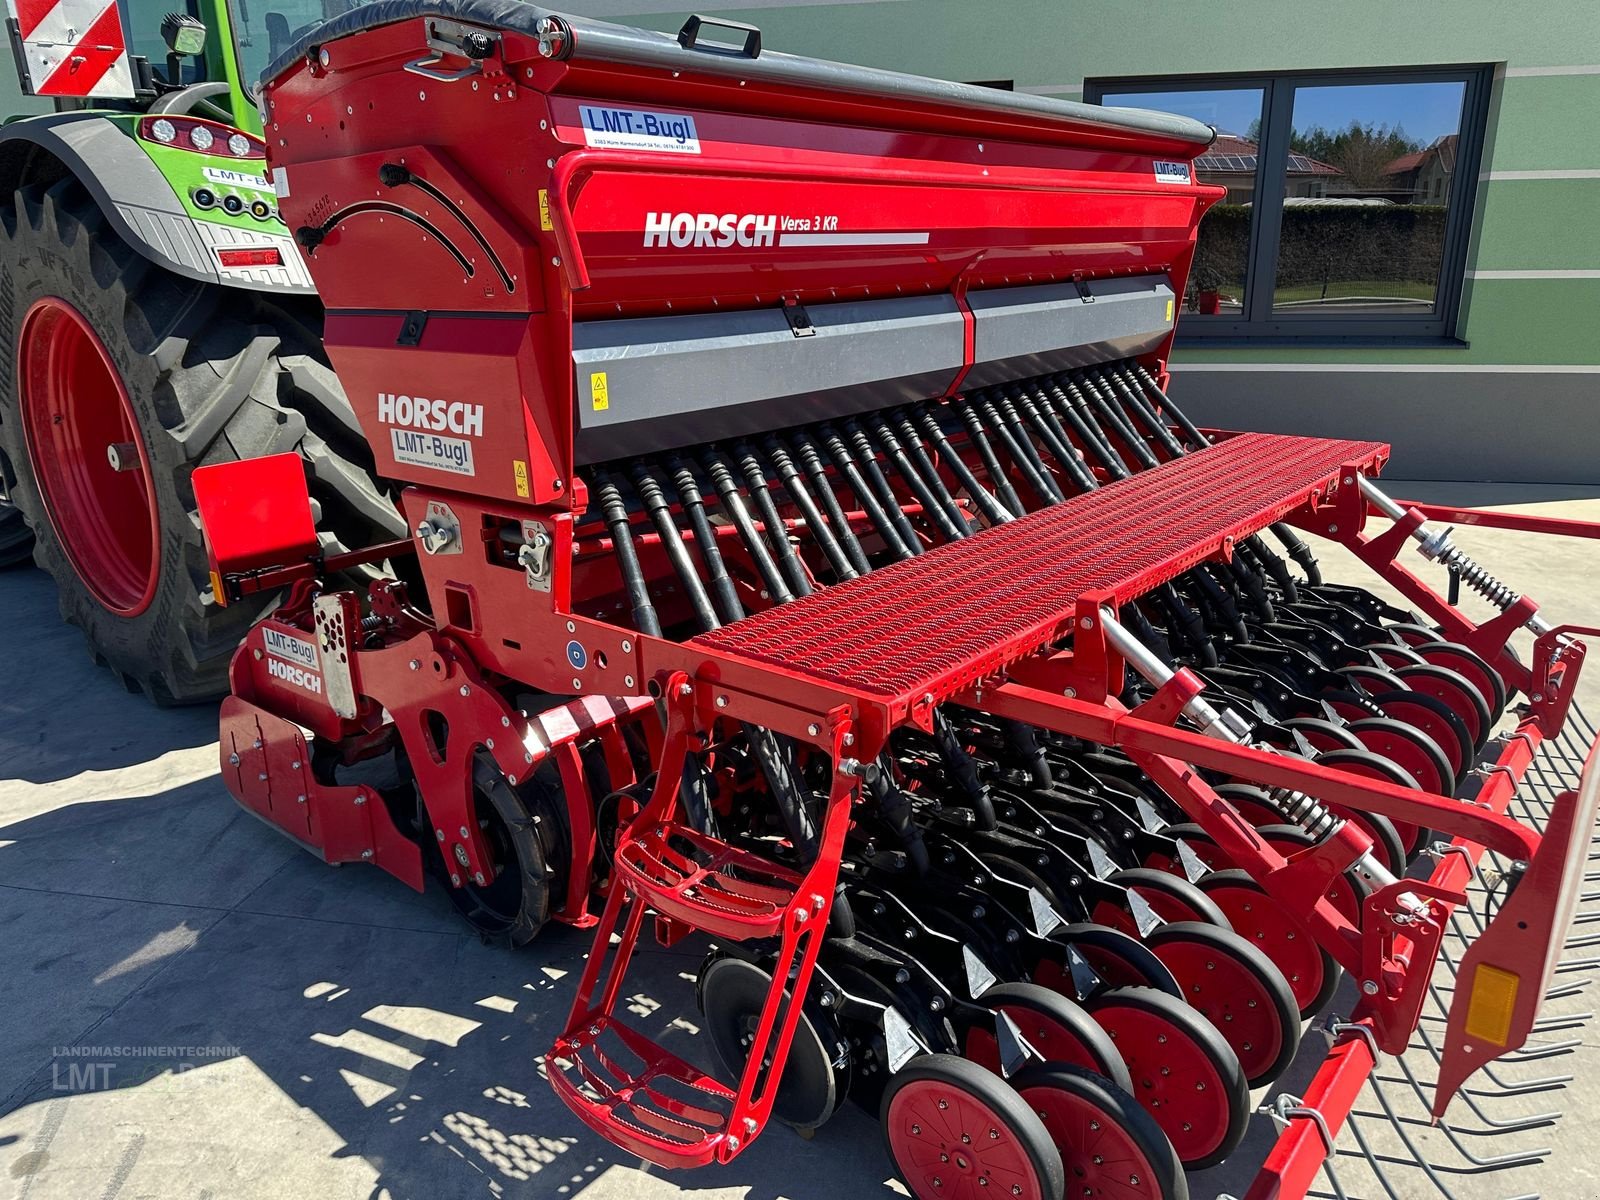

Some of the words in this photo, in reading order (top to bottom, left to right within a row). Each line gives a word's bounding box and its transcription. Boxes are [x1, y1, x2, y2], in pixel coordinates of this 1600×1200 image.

[586, 108, 692, 145] LMT-Bugl
[1155, 162, 1189, 179] LMT-Bugl
[643, 212, 776, 248] HORSCH
[780, 215, 810, 231] Versa
[812, 215, 821, 231] 3
[822, 215, 839, 231] KR
[377, 392, 484, 438] HORSCH
[395, 430, 468, 467] LMT-Bugl
[265, 629, 315, 664] LMT-Bugl
[268, 657, 321, 694] HORSCH
